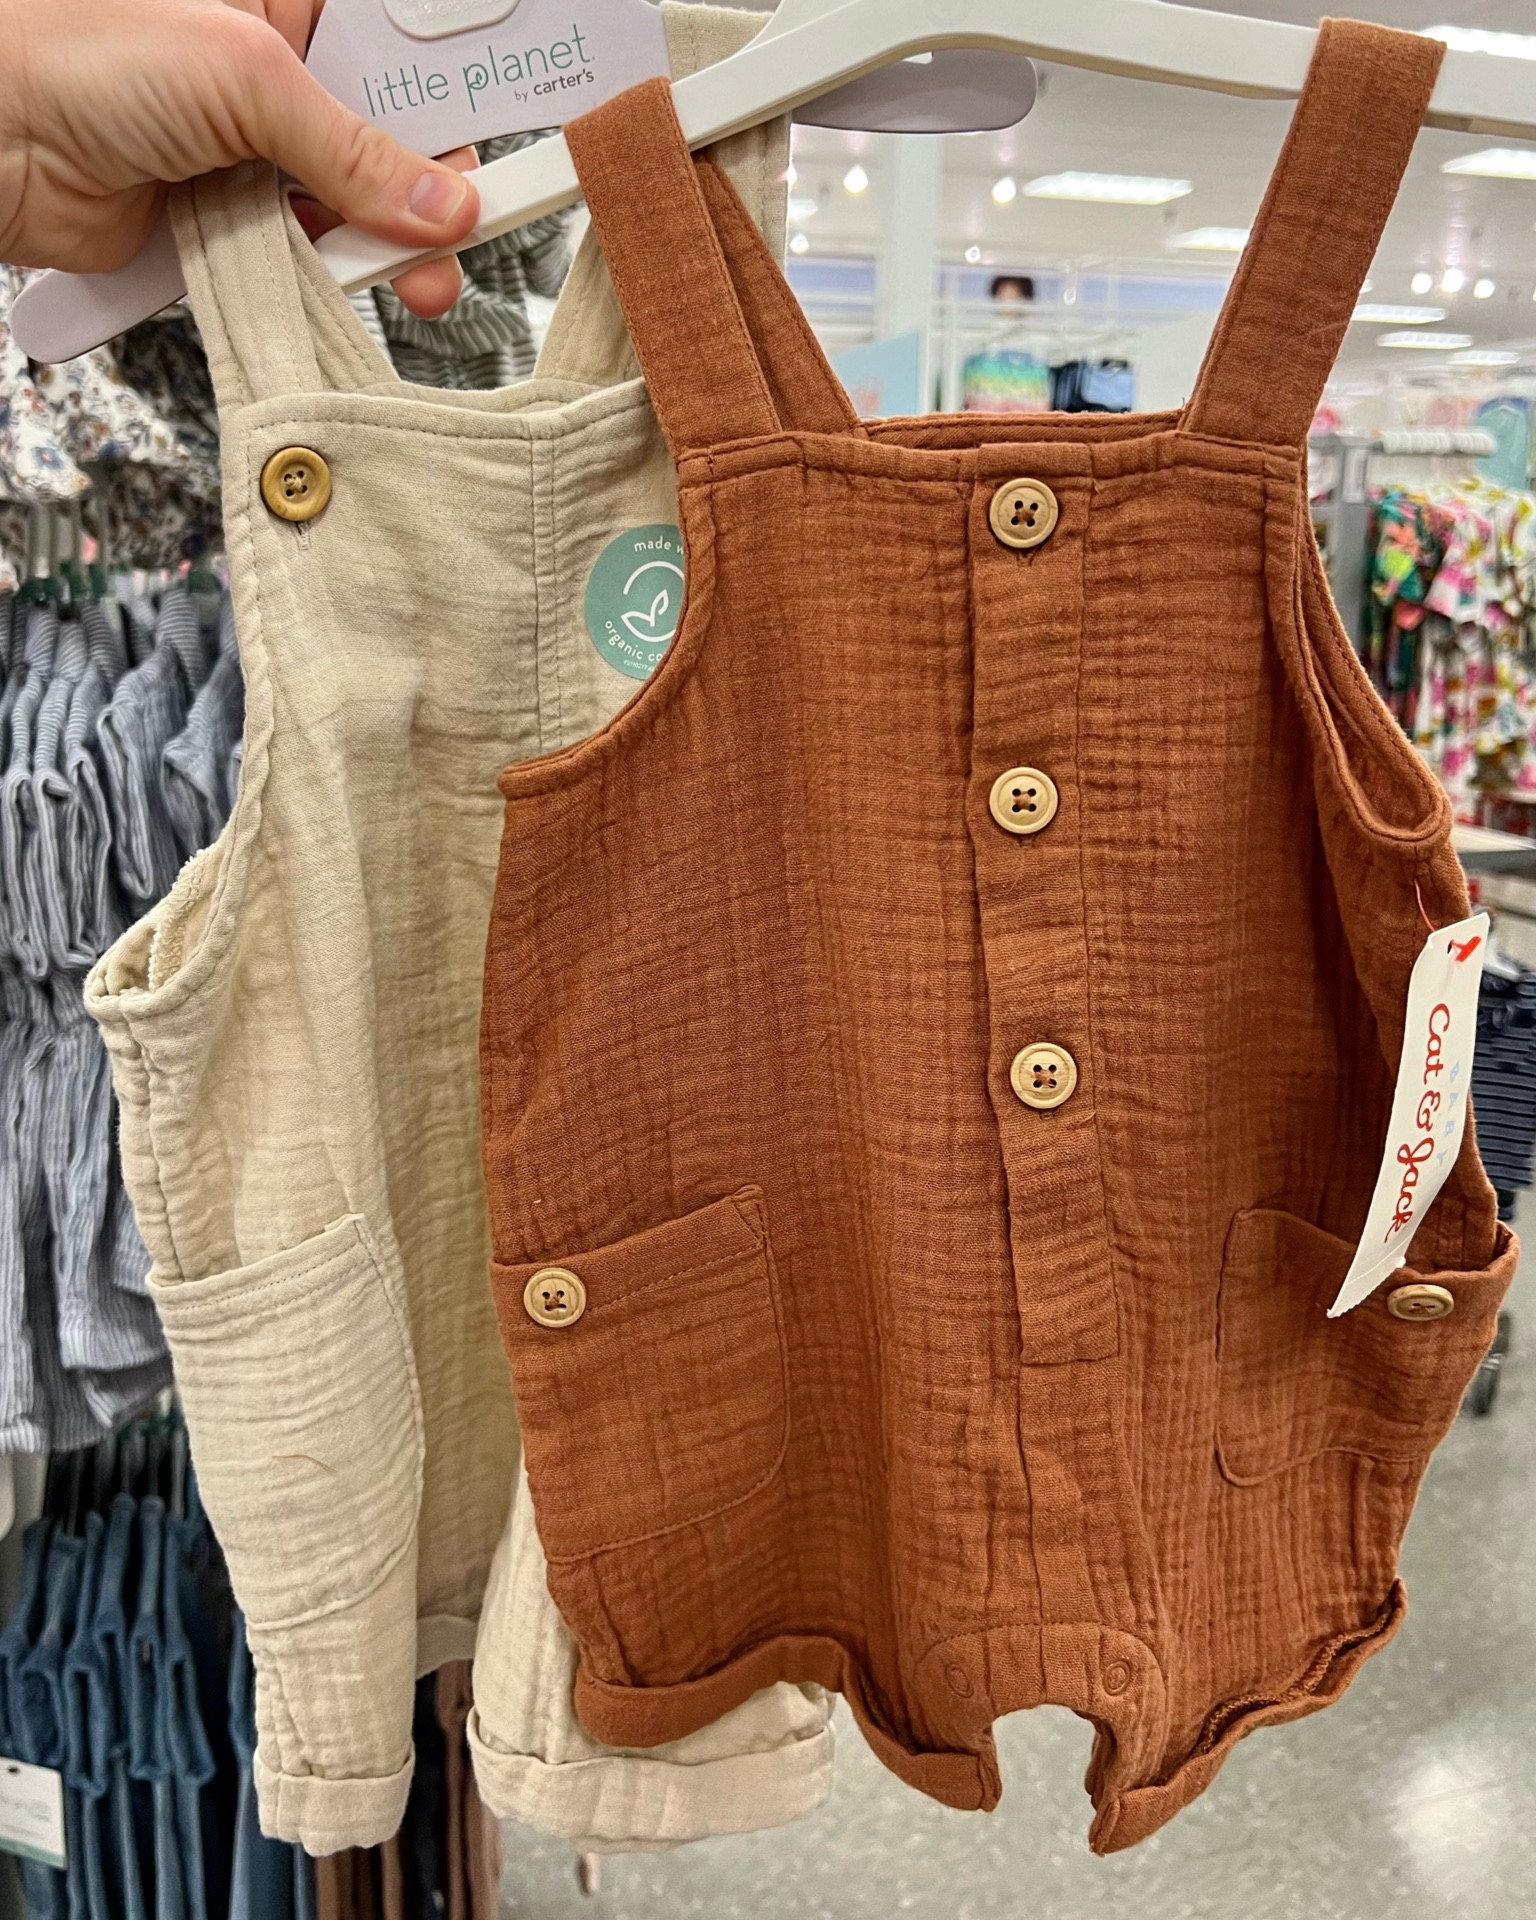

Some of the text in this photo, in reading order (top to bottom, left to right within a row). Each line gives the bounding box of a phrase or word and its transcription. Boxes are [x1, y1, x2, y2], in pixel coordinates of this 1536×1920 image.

[363, 23, 591, 118] little planet
[513, 67, 595, 104] by carter's
[633, 535, 672, 552] made
[604, 619, 644, 660] organic
[1384, 1003, 1450, 1244] Cat & Jack
